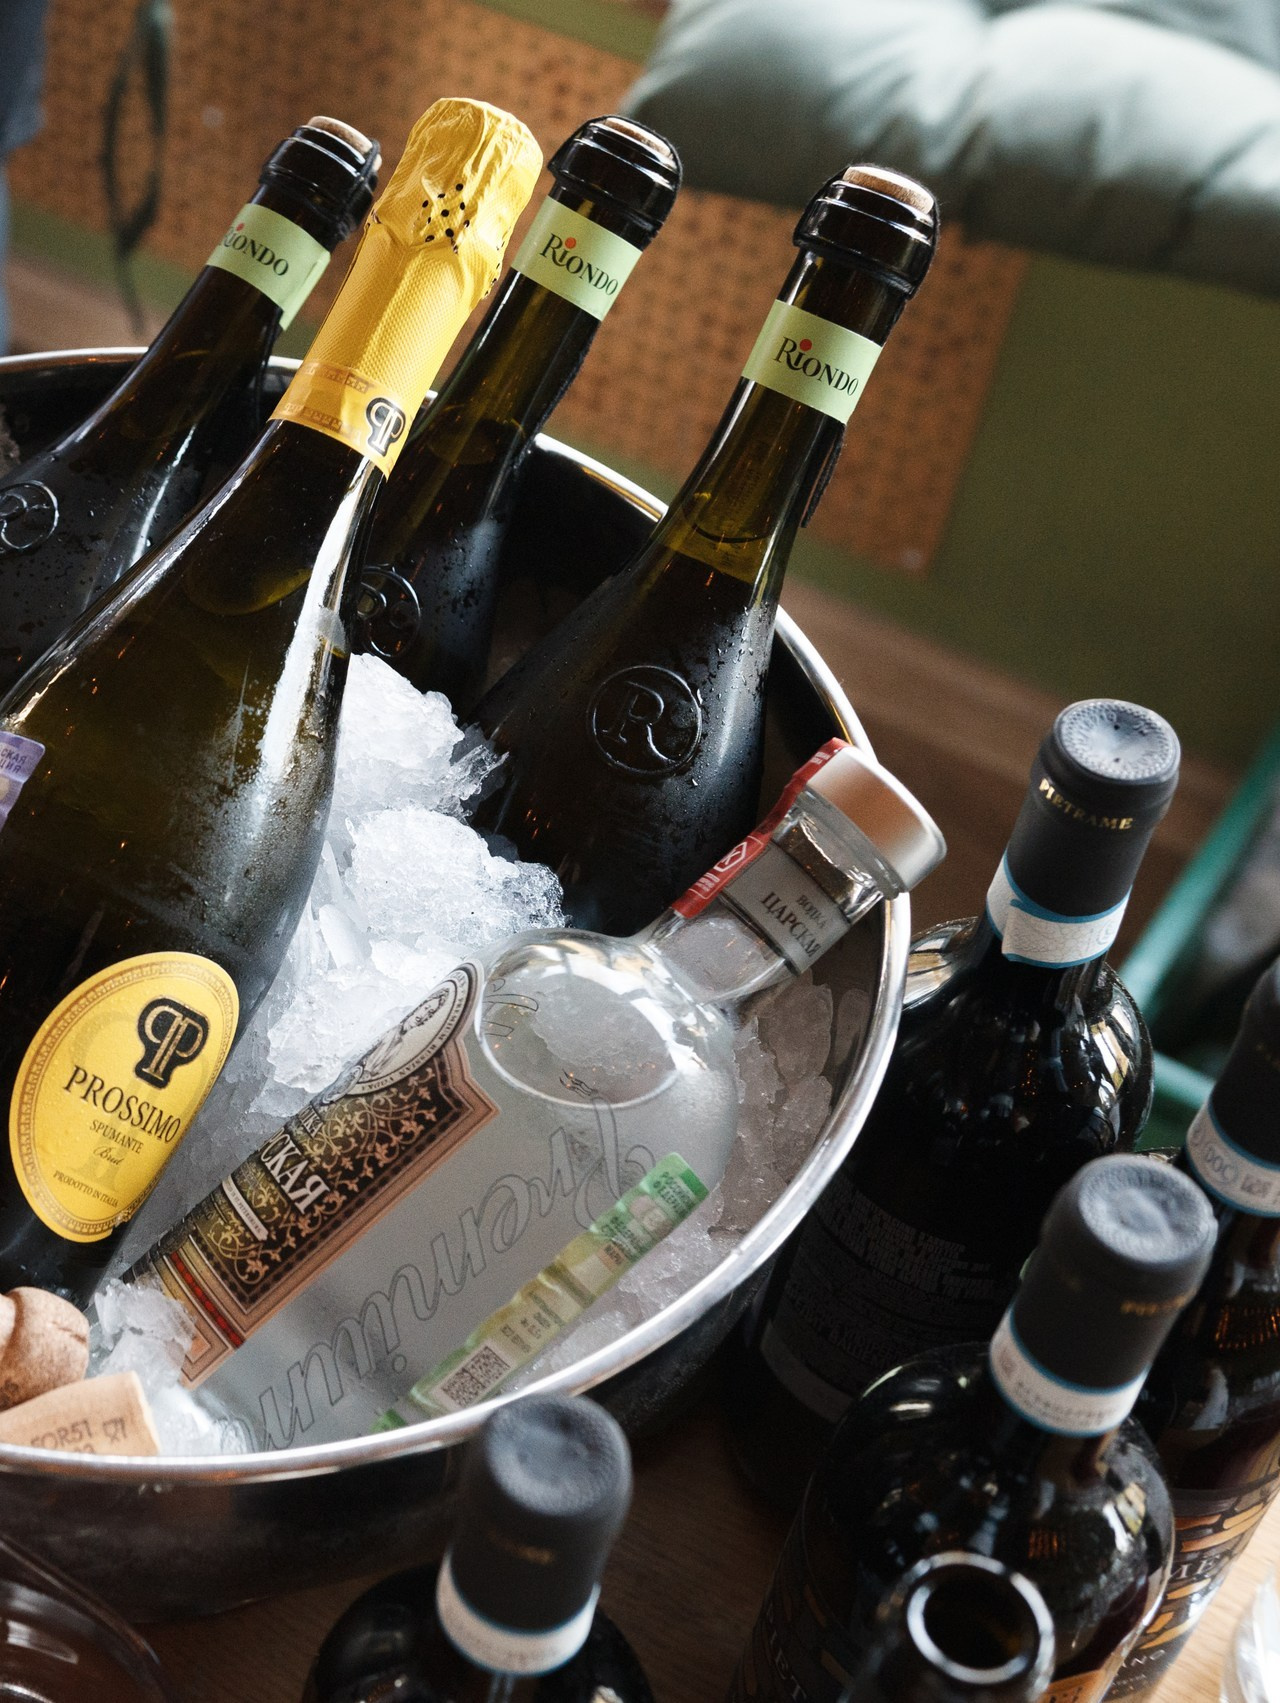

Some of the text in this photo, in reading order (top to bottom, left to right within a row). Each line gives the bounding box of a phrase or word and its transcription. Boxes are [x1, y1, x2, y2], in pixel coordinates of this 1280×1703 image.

[1038, 777, 1134, 831] PIETRAME
[760, 891, 824, 958] ЦАРСКАЯ
[797, 893, 827, 930] ВОДКА
[398, 1044, 438, 1077] RUSSIAN
[63, 1065, 182, 1143] PROSSIMO
[90, 1119, 144, 1154] SPUMANTE
[93, 1146, 125, 1166] Brut
[258, 1127, 331, 1215] РСКАЯ
[53, 1170, 94, 1198] PRODOTTO
[100, 1191, 119, 1208] ITALIA
